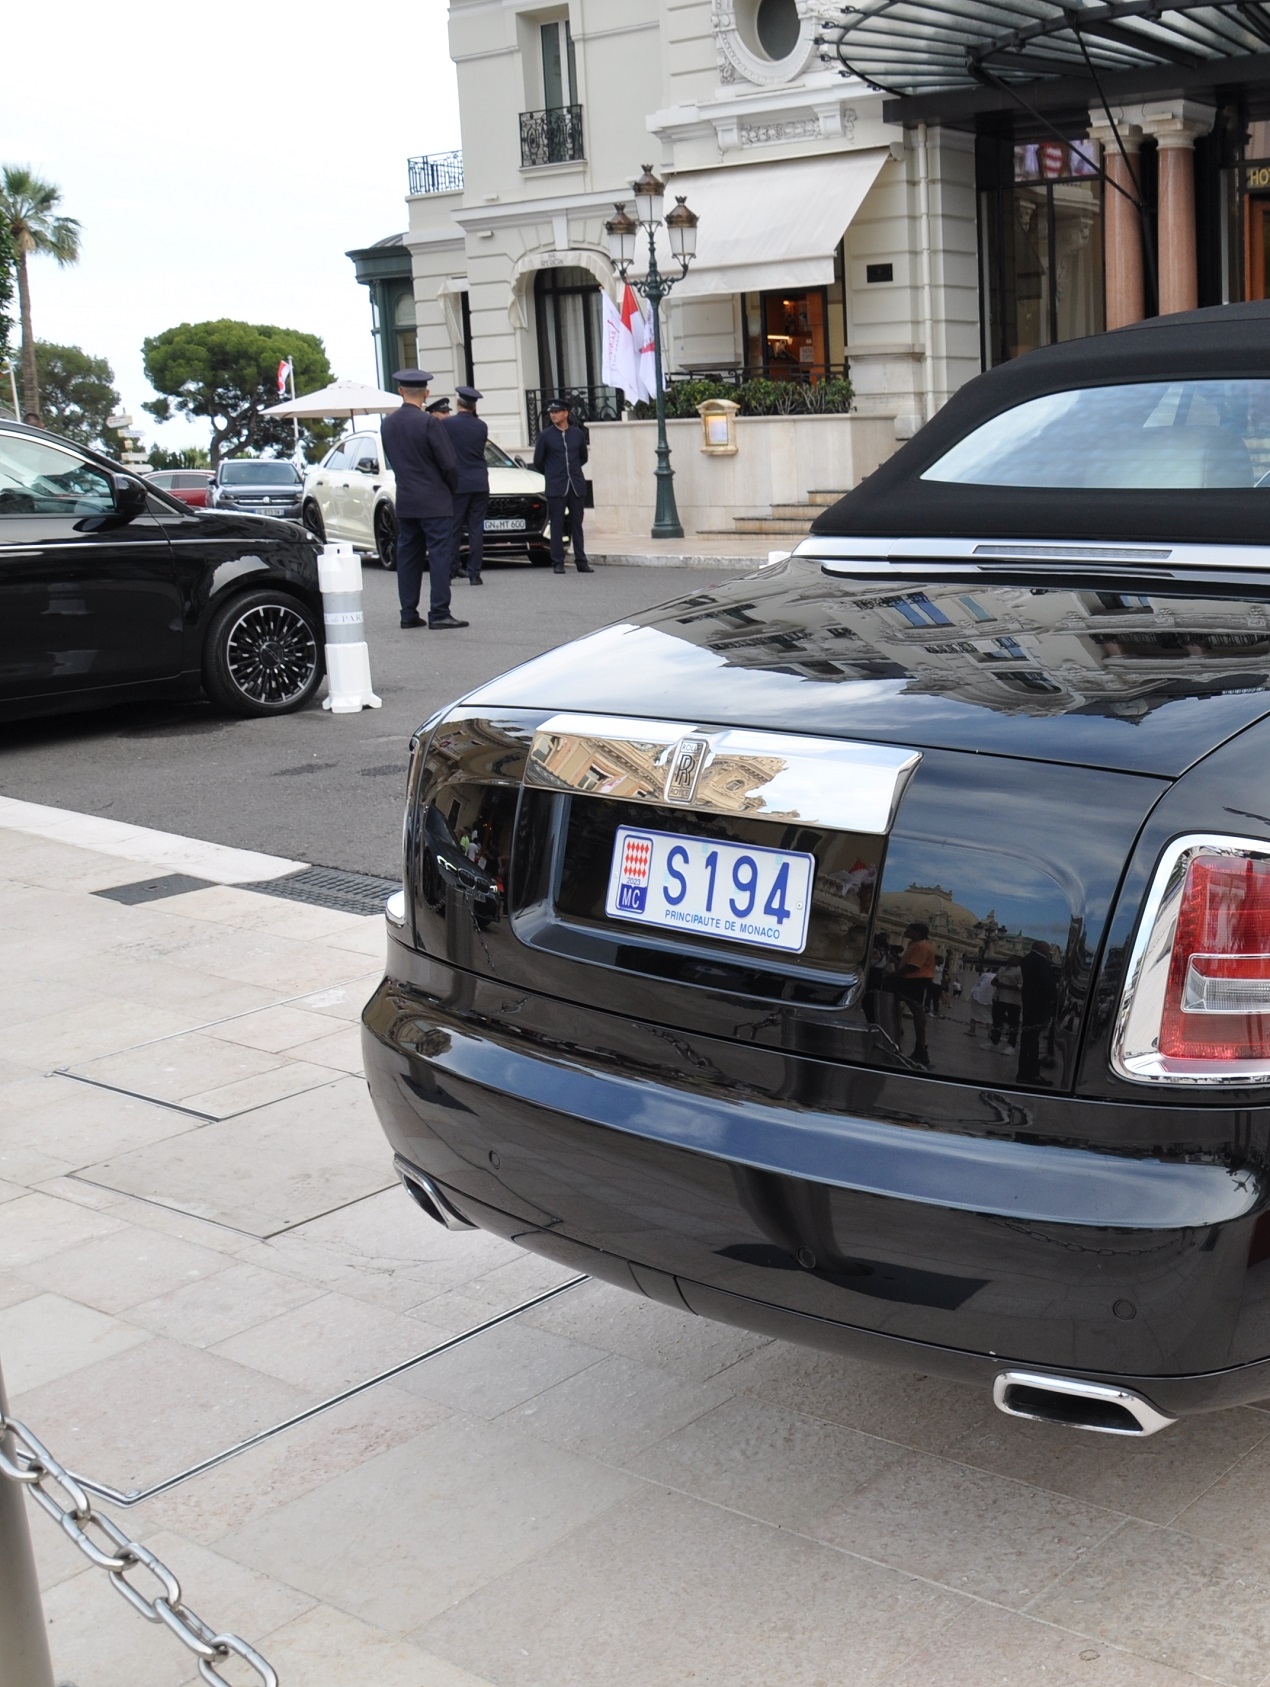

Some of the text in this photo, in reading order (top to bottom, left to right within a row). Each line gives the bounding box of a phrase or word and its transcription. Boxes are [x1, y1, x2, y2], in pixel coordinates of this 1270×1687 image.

[626, 876, 641, 886] 2023
[662, 845, 791, 925] S194
[621, 889, 641, 909] MC
[664, 909, 781, 940] PRINCIPAUTE DE MONACO
